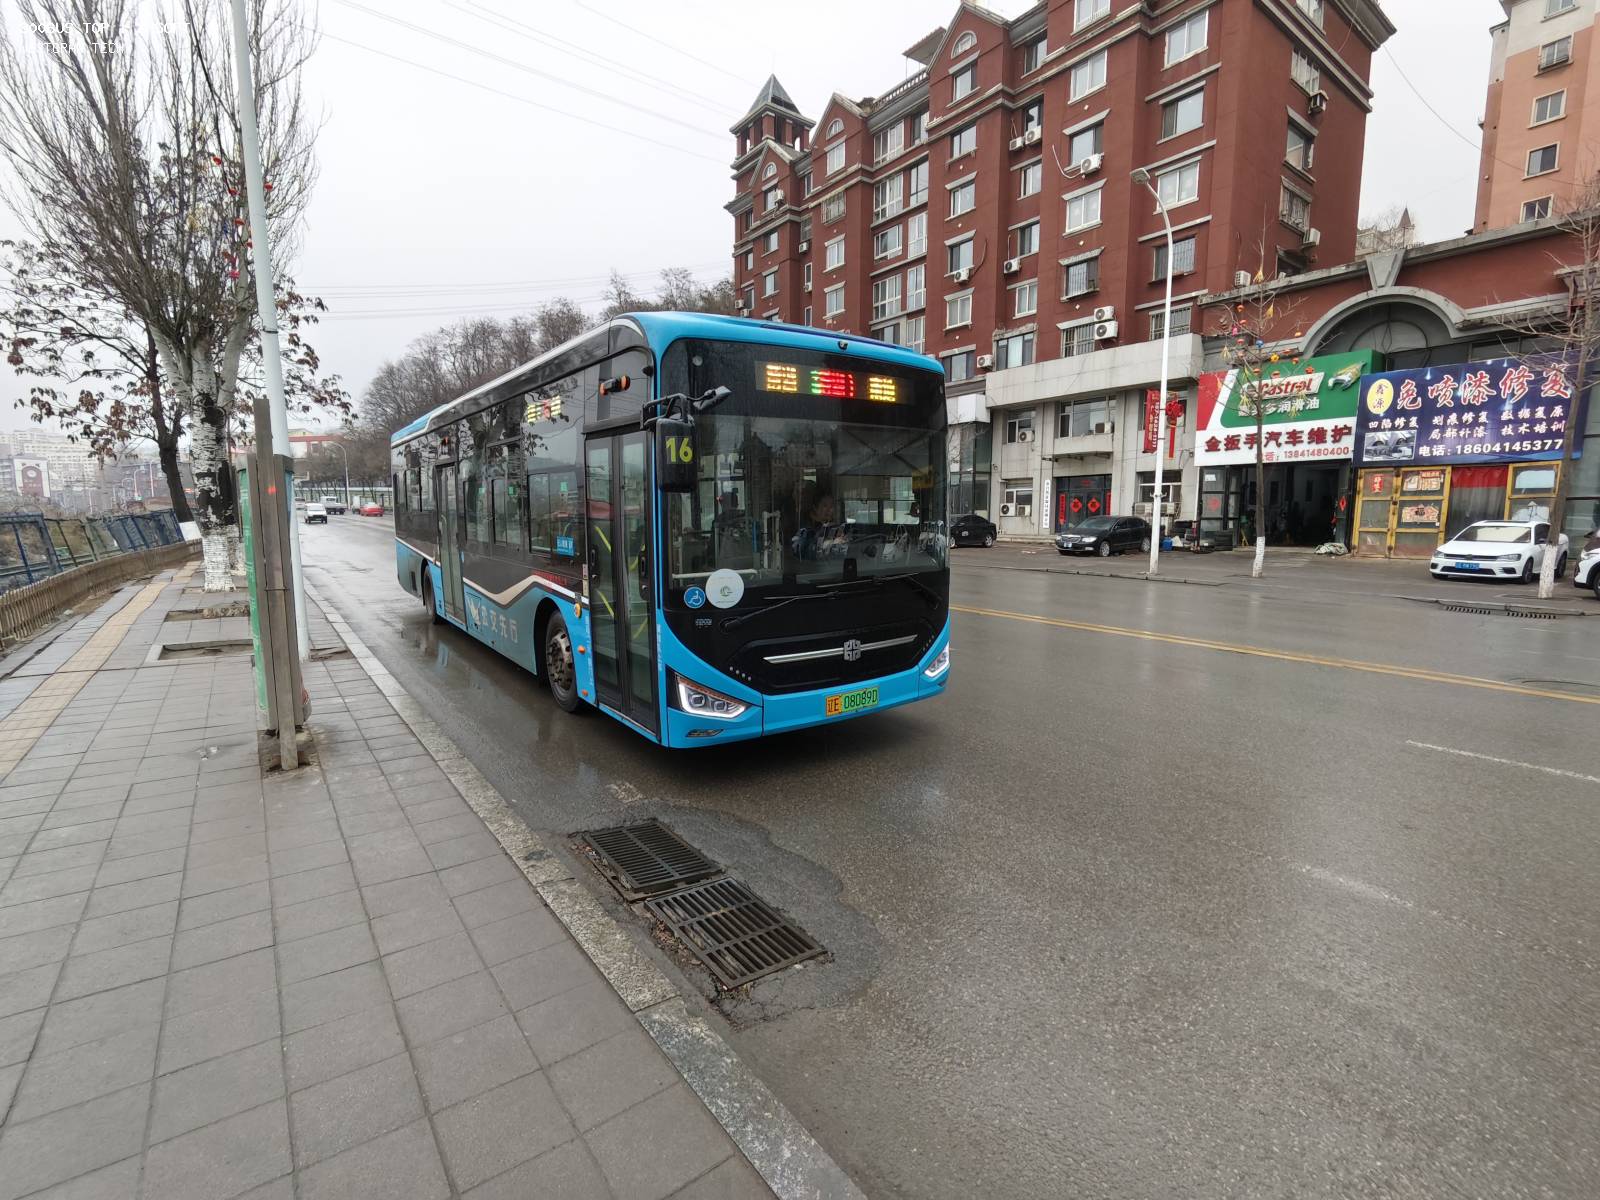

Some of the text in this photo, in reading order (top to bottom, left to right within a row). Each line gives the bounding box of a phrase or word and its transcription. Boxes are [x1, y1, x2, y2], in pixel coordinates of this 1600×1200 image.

[1397, 363, 1570, 409] 免喷漆修复
[1368, 416, 1419, 430] 凹陷修复
[1428, 420, 1566, 440] 局部补漆 技术培训
[665, 437, 693, 463] 16
